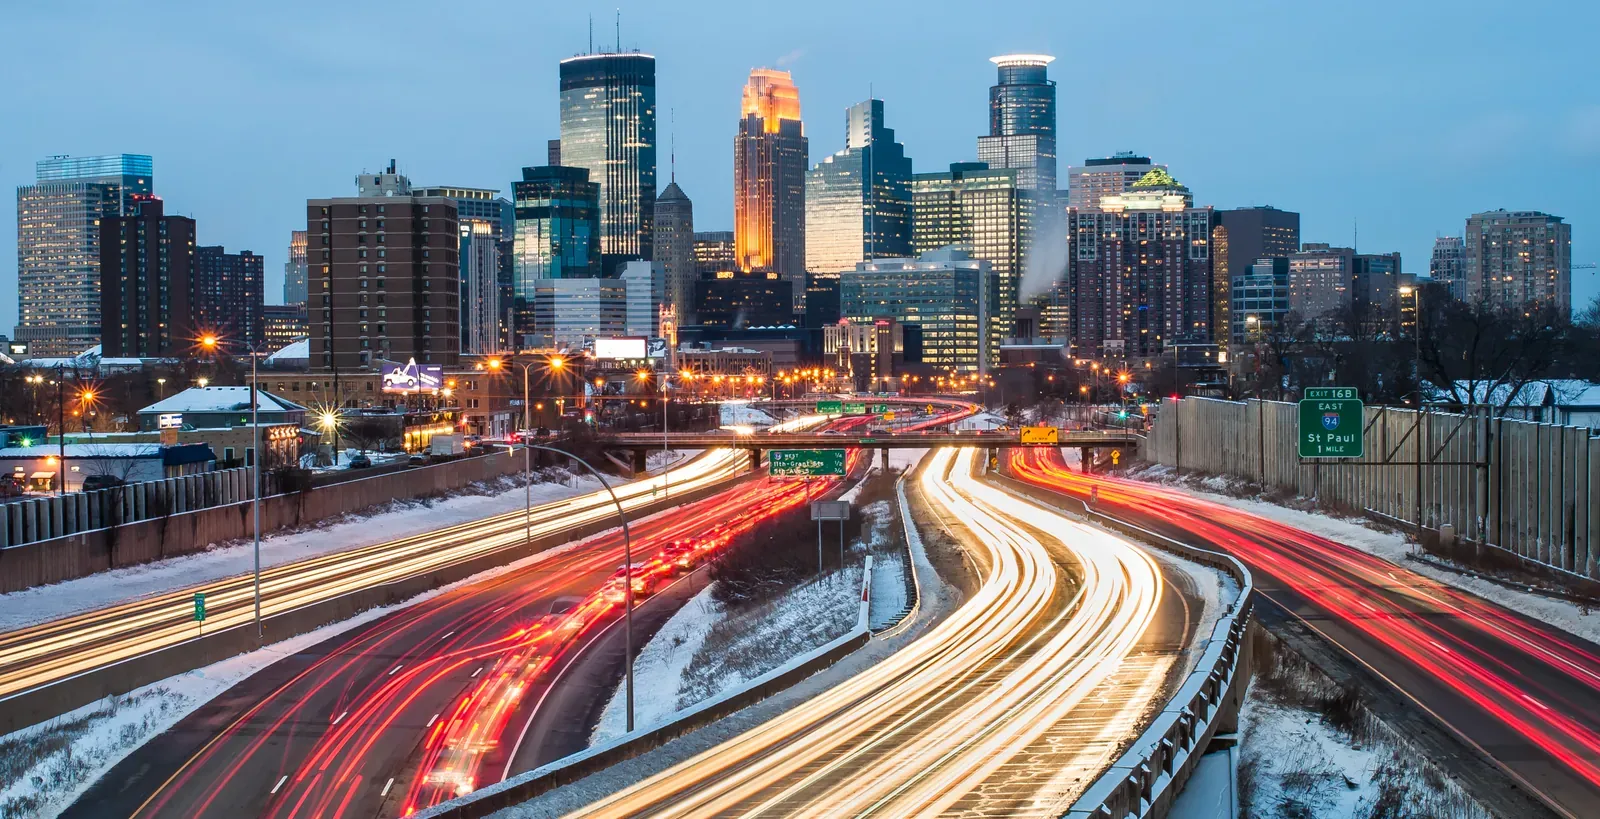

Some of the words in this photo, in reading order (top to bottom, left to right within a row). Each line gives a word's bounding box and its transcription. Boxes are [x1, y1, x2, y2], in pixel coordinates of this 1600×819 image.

[1332, 390, 1352, 398] 16B
[1308, 433, 1320, 442] St
[1327, 433, 1354, 442] Paul
[1318, 445, 1321, 453] 1
